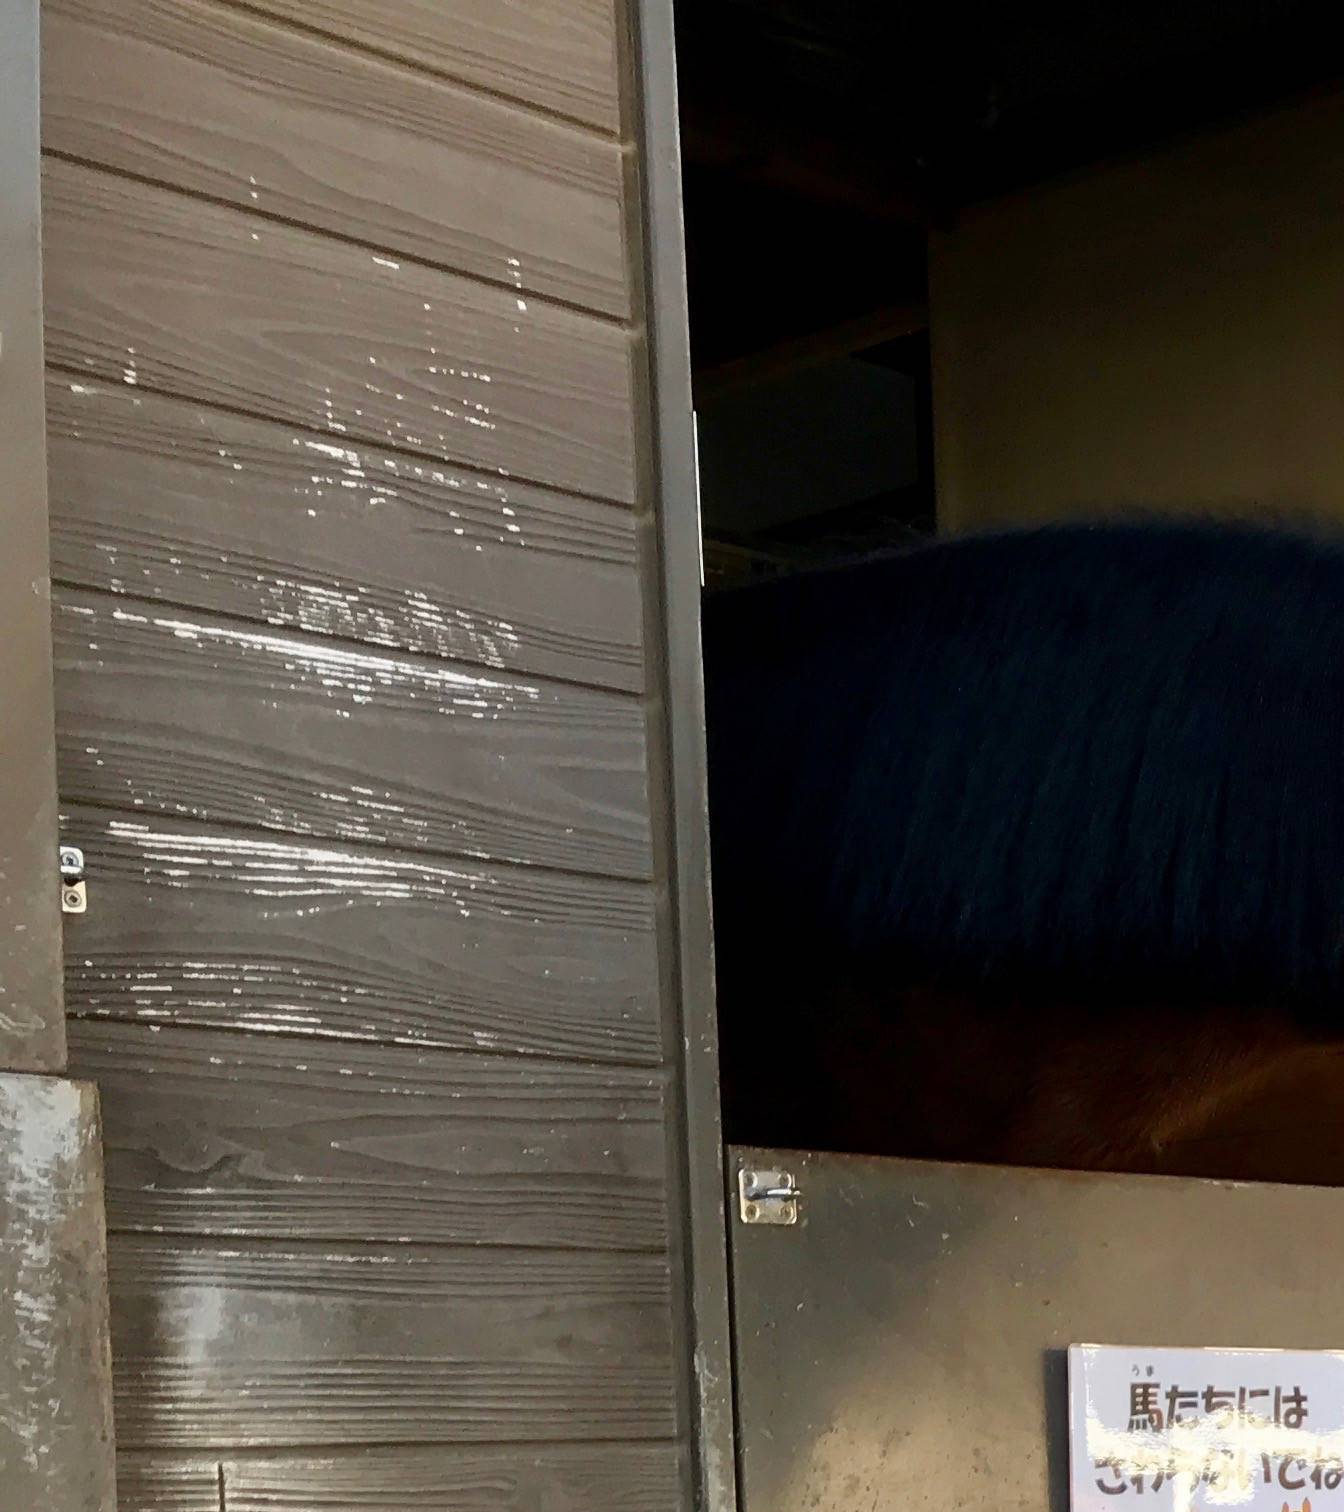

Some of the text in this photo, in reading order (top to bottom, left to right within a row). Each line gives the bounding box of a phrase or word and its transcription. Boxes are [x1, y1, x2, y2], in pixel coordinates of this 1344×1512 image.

[1127, 1382, 1308, 1432] 馬たちには
